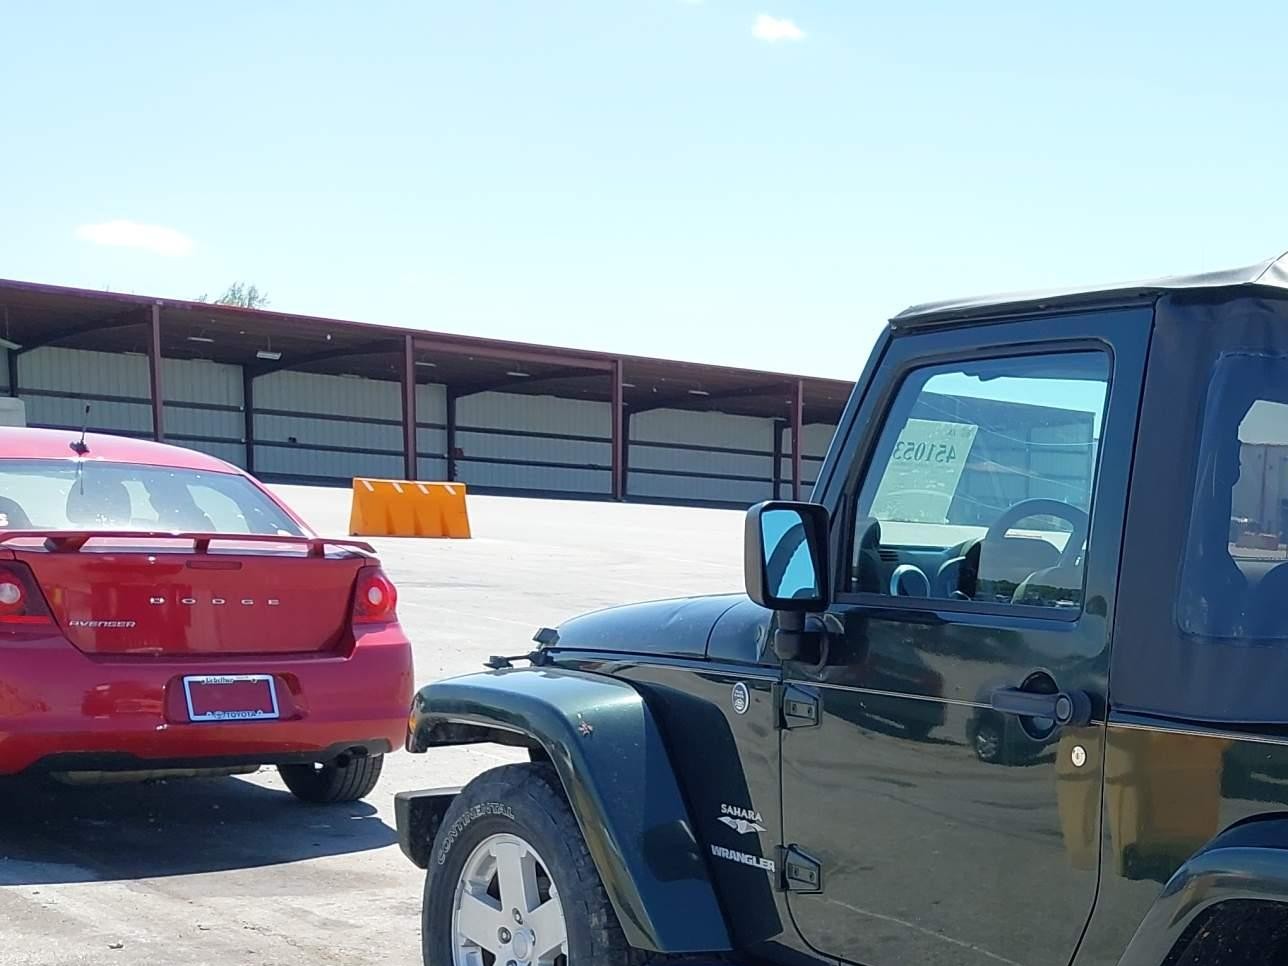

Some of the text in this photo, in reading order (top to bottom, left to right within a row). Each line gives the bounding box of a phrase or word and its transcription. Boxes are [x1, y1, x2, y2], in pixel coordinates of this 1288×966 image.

[149, 597, 280, 605] DODGE
[69, 620, 136, 628] AVENGER
[720, 803, 763, 822] SAHARA
[438, 802, 515, 865] CONTINENTAL
[710, 844, 776, 873] WRANGLER
